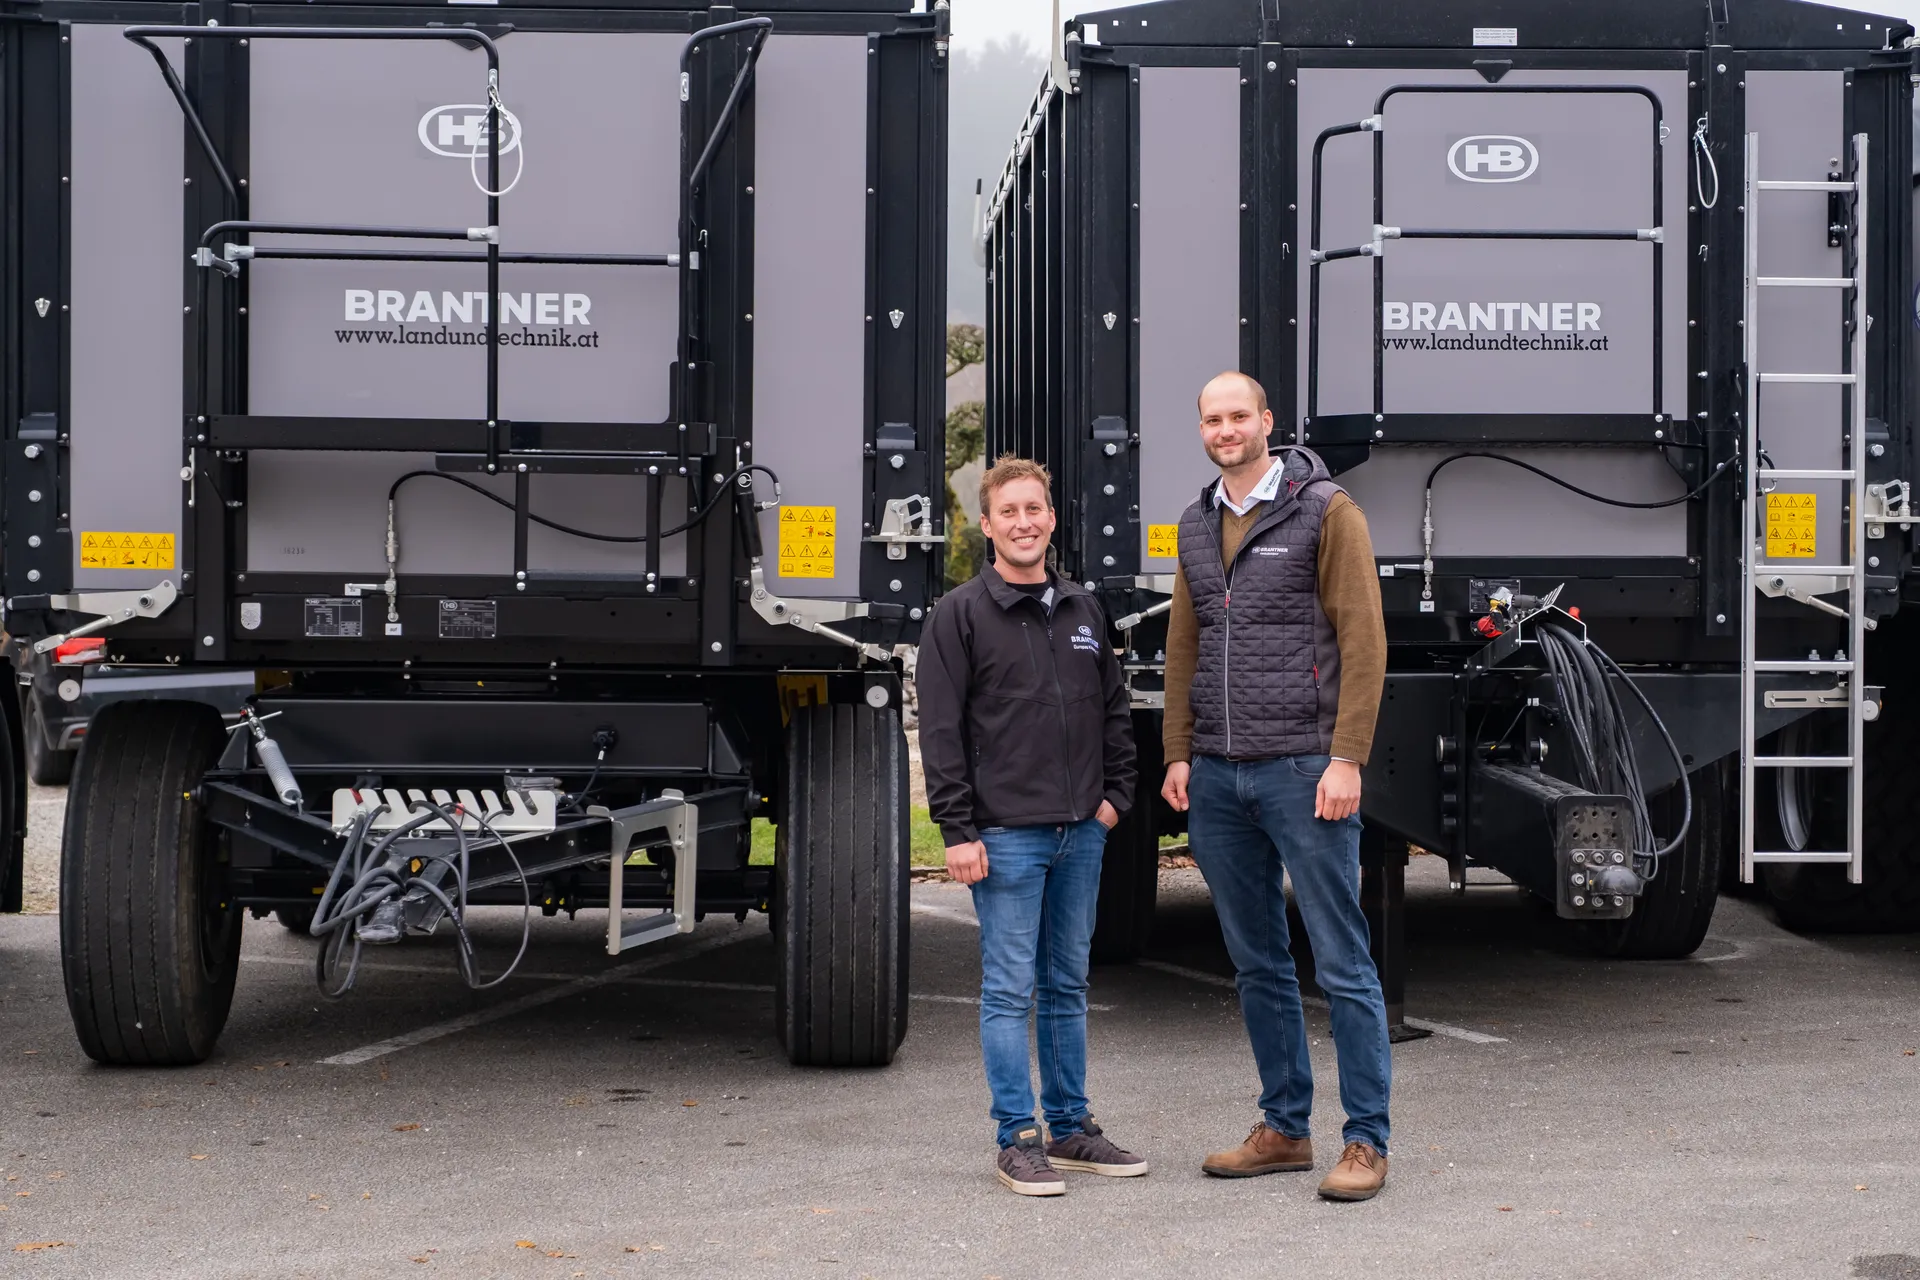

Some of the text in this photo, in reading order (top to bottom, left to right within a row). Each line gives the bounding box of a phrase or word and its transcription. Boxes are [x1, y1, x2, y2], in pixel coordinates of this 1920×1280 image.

[1465, 144, 1525, 172] HB
[344, 289, 592, 325] BRANTNER
[1382, 301, 1602, 331] BRANTNER
[334, 324, 600, 348] www.landundechnik.at
